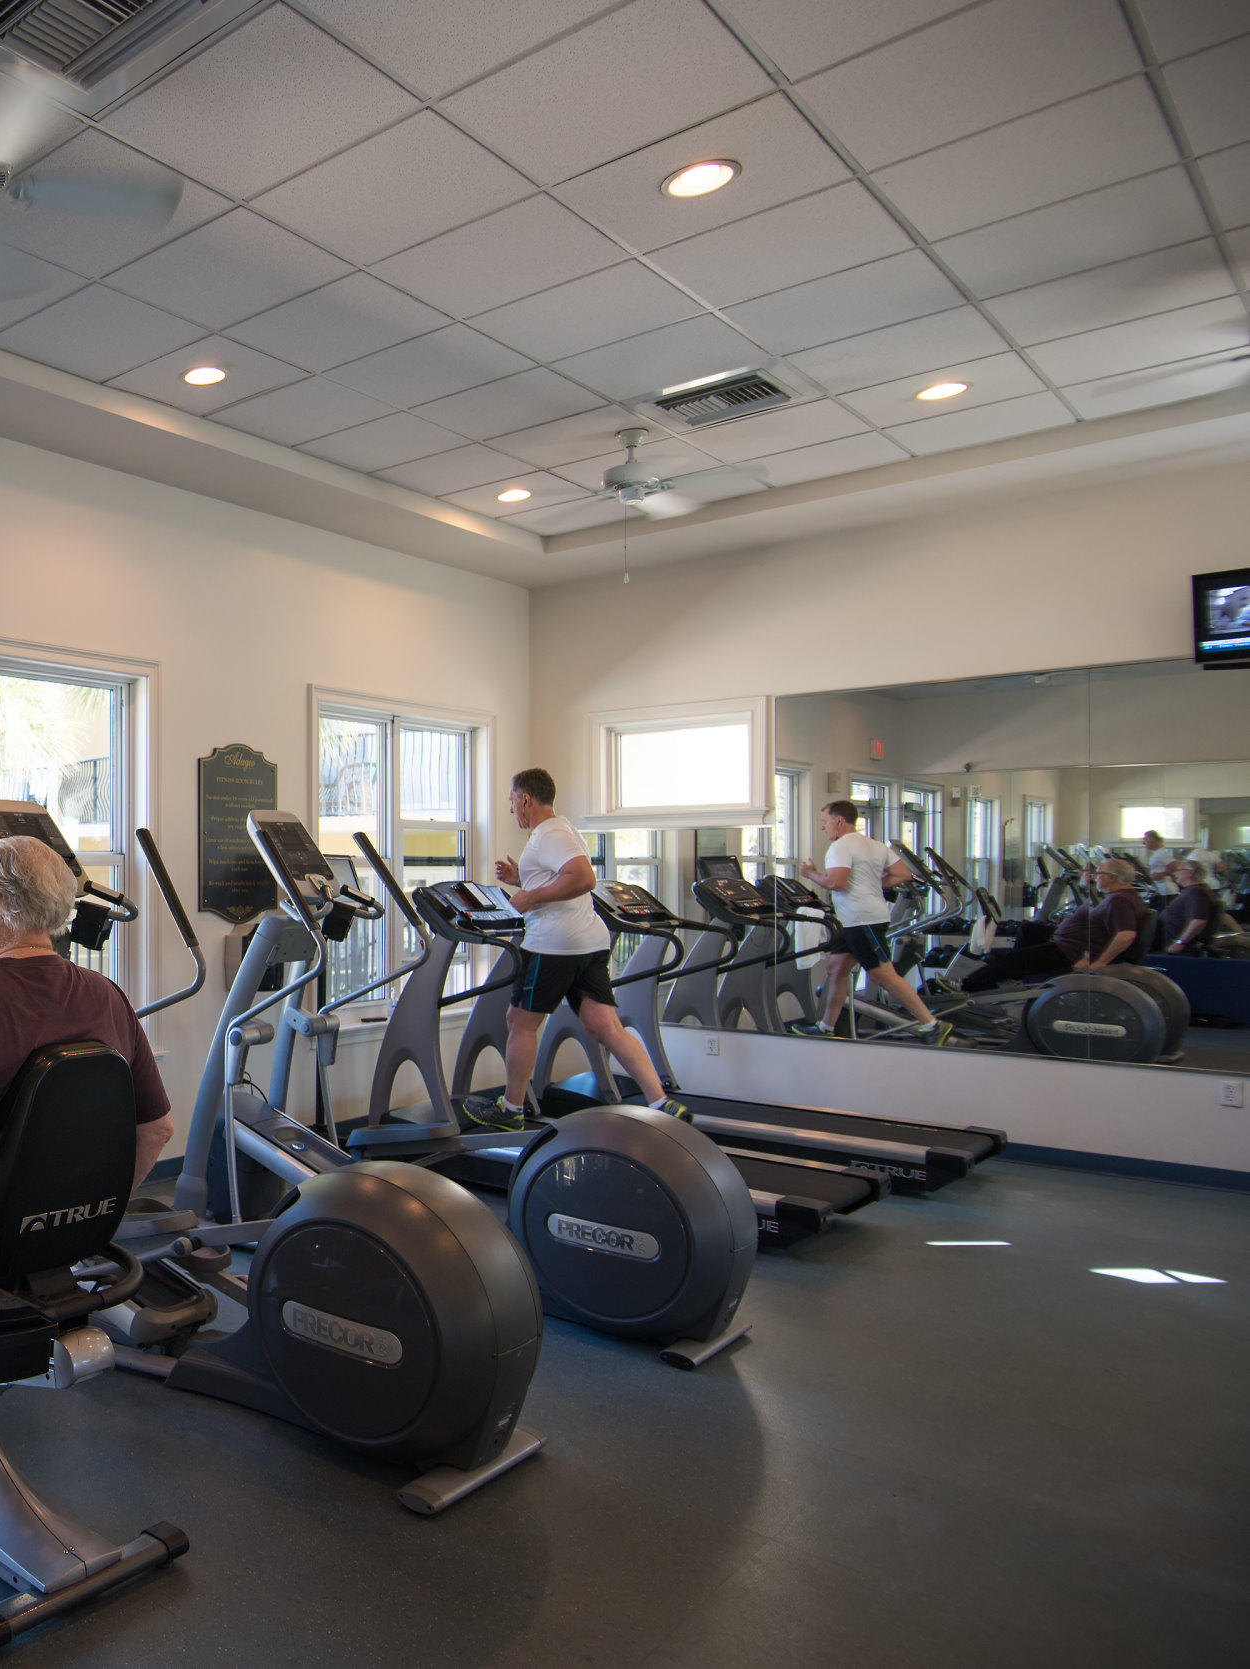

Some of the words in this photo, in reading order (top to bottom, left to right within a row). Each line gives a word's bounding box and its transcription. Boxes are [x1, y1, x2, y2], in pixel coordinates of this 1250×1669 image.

[49, 1197, 117, 1228] TRUE
[557, 1219, 635, 1252] PRECOR
[292, 1308, 375, 1355] PRECOR
